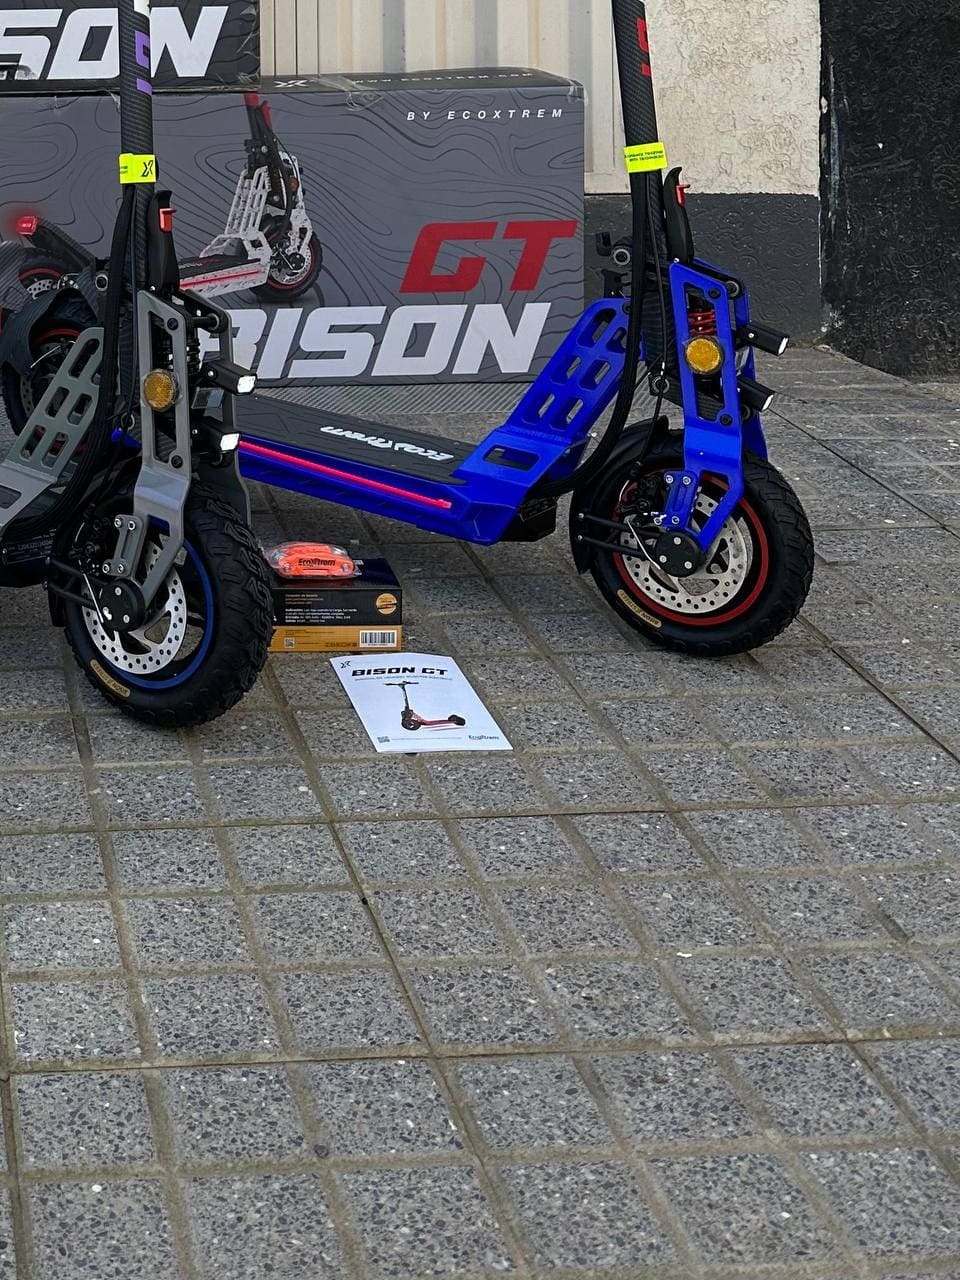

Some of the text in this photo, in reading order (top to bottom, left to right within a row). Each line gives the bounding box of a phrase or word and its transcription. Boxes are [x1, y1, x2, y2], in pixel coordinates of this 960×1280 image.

[406, 108, 563, 121] BY ECOXTREM
[398, 221, 577, 293] GT
[198, 303, 552, 380] BISON
[352, 667, 448, 676] BISON GT
